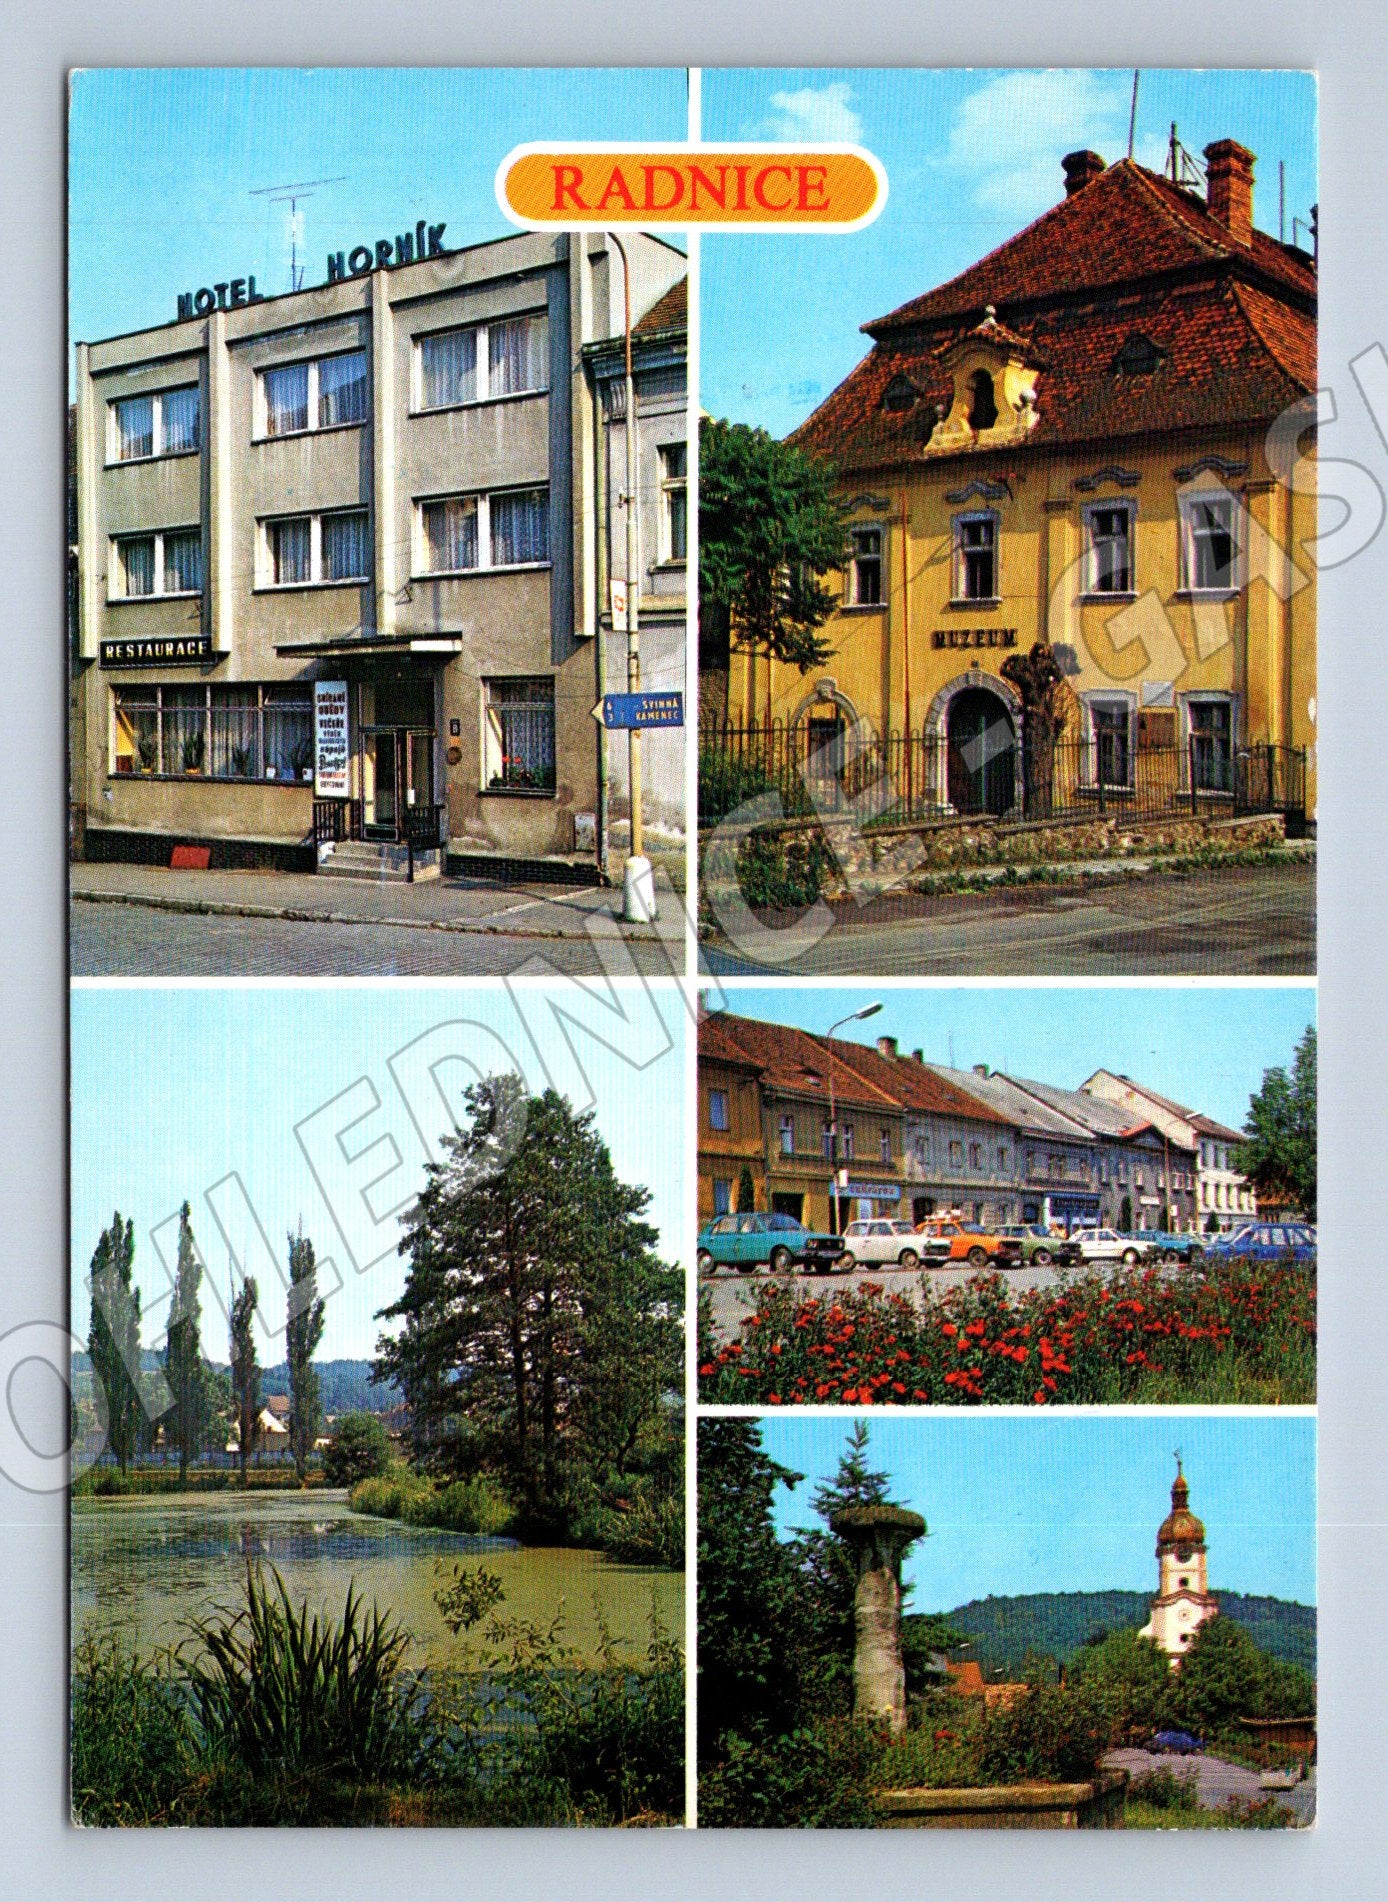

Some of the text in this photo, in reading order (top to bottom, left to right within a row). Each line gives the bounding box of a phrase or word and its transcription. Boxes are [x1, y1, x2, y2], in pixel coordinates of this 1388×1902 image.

[550, 165, 831, 212] RADNICE
[176, 220, 448, 320] HOTEL HORNÍK
[105, 641, 208, 658] RESTAURACE
[930, 628, 1018, 650] MUZEUM
[635, 711, 679, 721] KAMENEC
